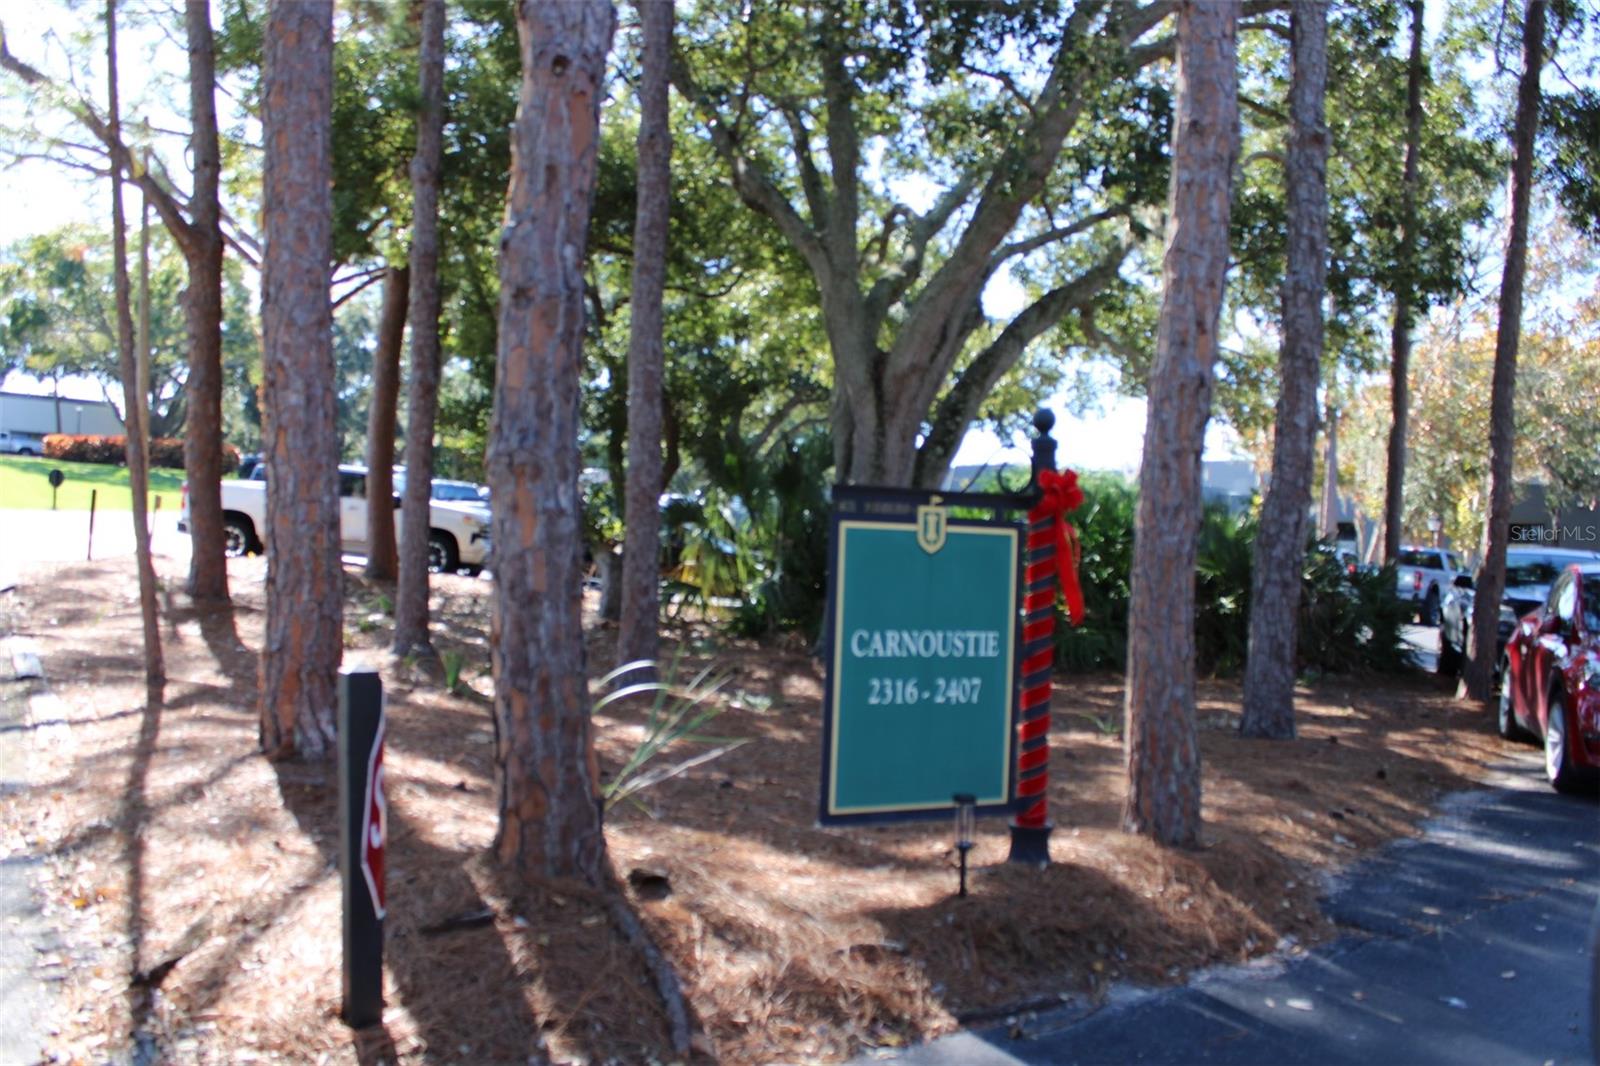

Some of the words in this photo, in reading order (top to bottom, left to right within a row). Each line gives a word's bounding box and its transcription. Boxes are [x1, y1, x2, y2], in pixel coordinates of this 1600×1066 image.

[850, 628, 1000, 658] CARNOUSTIE
[868, 677, 918, 705] 2316
[934, 676, 982, 704] 2407
